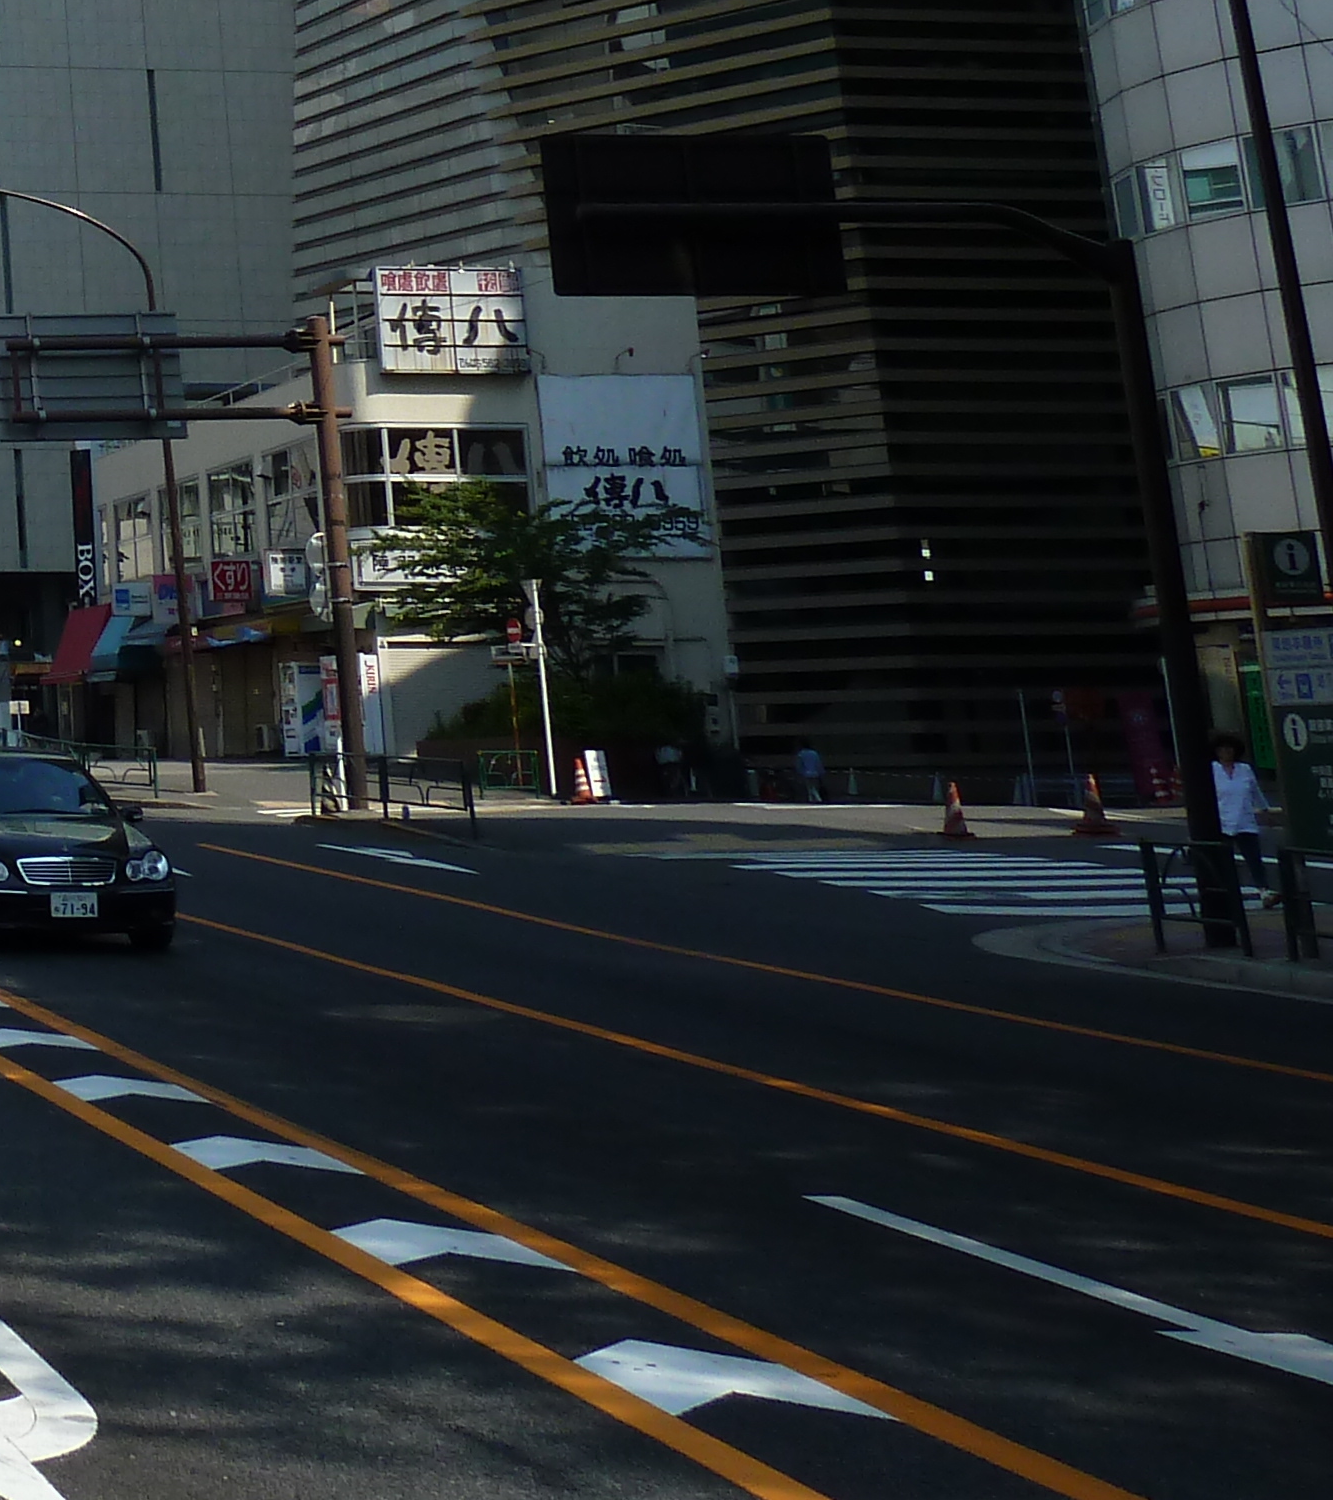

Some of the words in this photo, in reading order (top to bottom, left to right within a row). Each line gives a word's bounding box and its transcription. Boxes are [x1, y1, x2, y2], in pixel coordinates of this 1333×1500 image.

[76, 542, 96, 596] BOX
[213, 560, 250, 594] くすり
